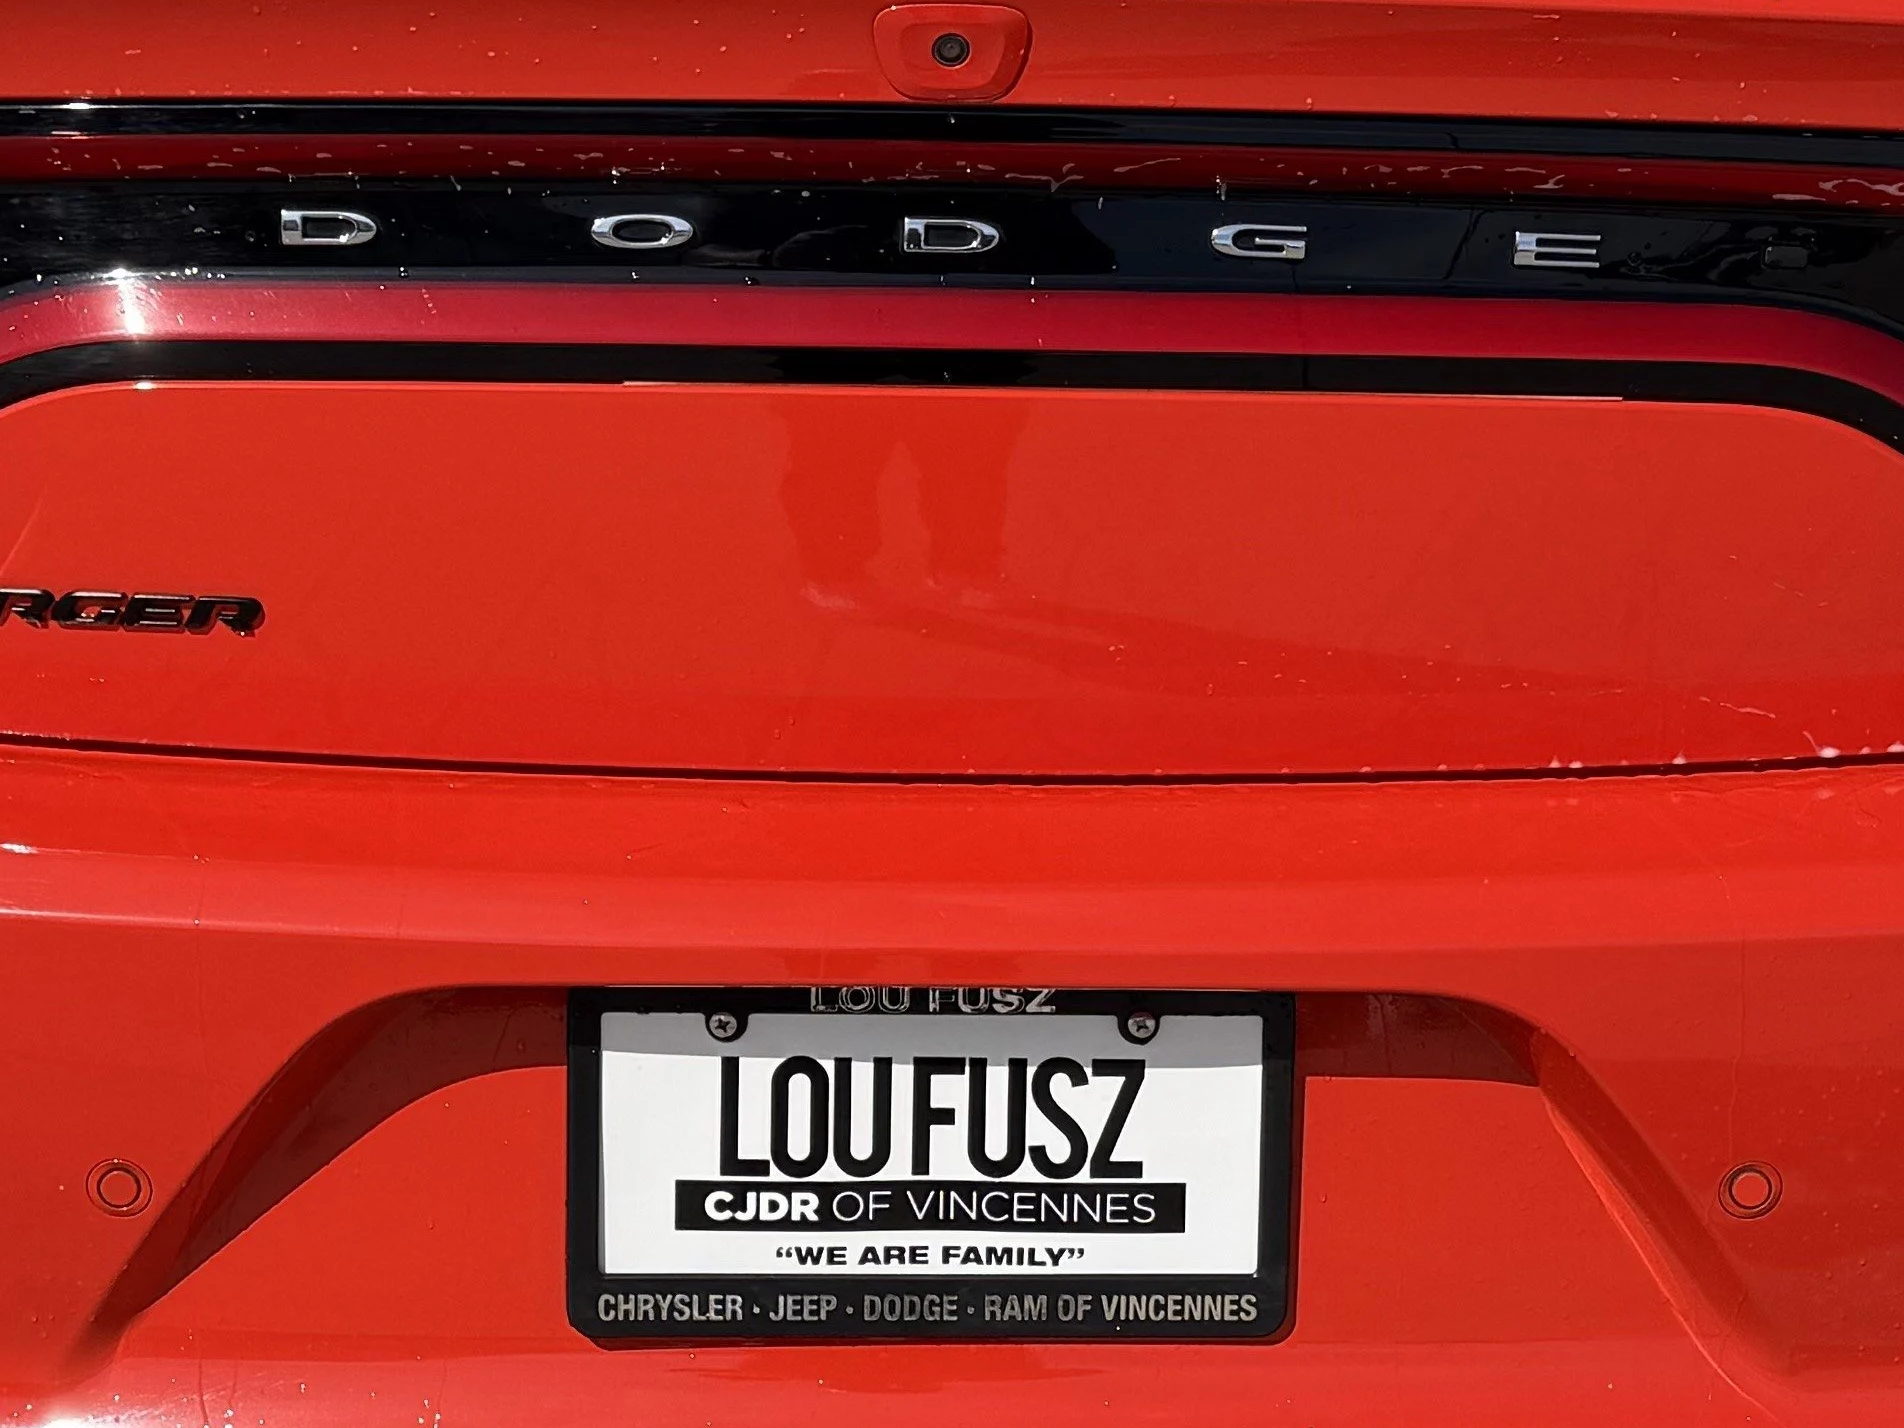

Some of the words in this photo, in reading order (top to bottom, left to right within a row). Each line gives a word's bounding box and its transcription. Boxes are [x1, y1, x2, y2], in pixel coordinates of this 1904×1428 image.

[280, 207, 1601, 270] DODGE
[809, 986, 911, 1014] LOU
[928, 986, 1057, 1015] FUSZ
[703, 1190, 820, 1222] CJDR
[831, 1190, 893, 1221] OF
[905, 1190, 1156, 1224] VINCENNES
[858, 1245, 930, 1266] ARE
[597, 1293, 743, 1322] CHRYSLER
[768, 1293, 838, 1322] JEEP
[863, 1293, 959, 1322] DODGE
[984, 1293, 1048, 1322] RAM
[1057, 1293, 1093, 1322] OF
[1100, 1293, 1258, 1322] VINCENNES
